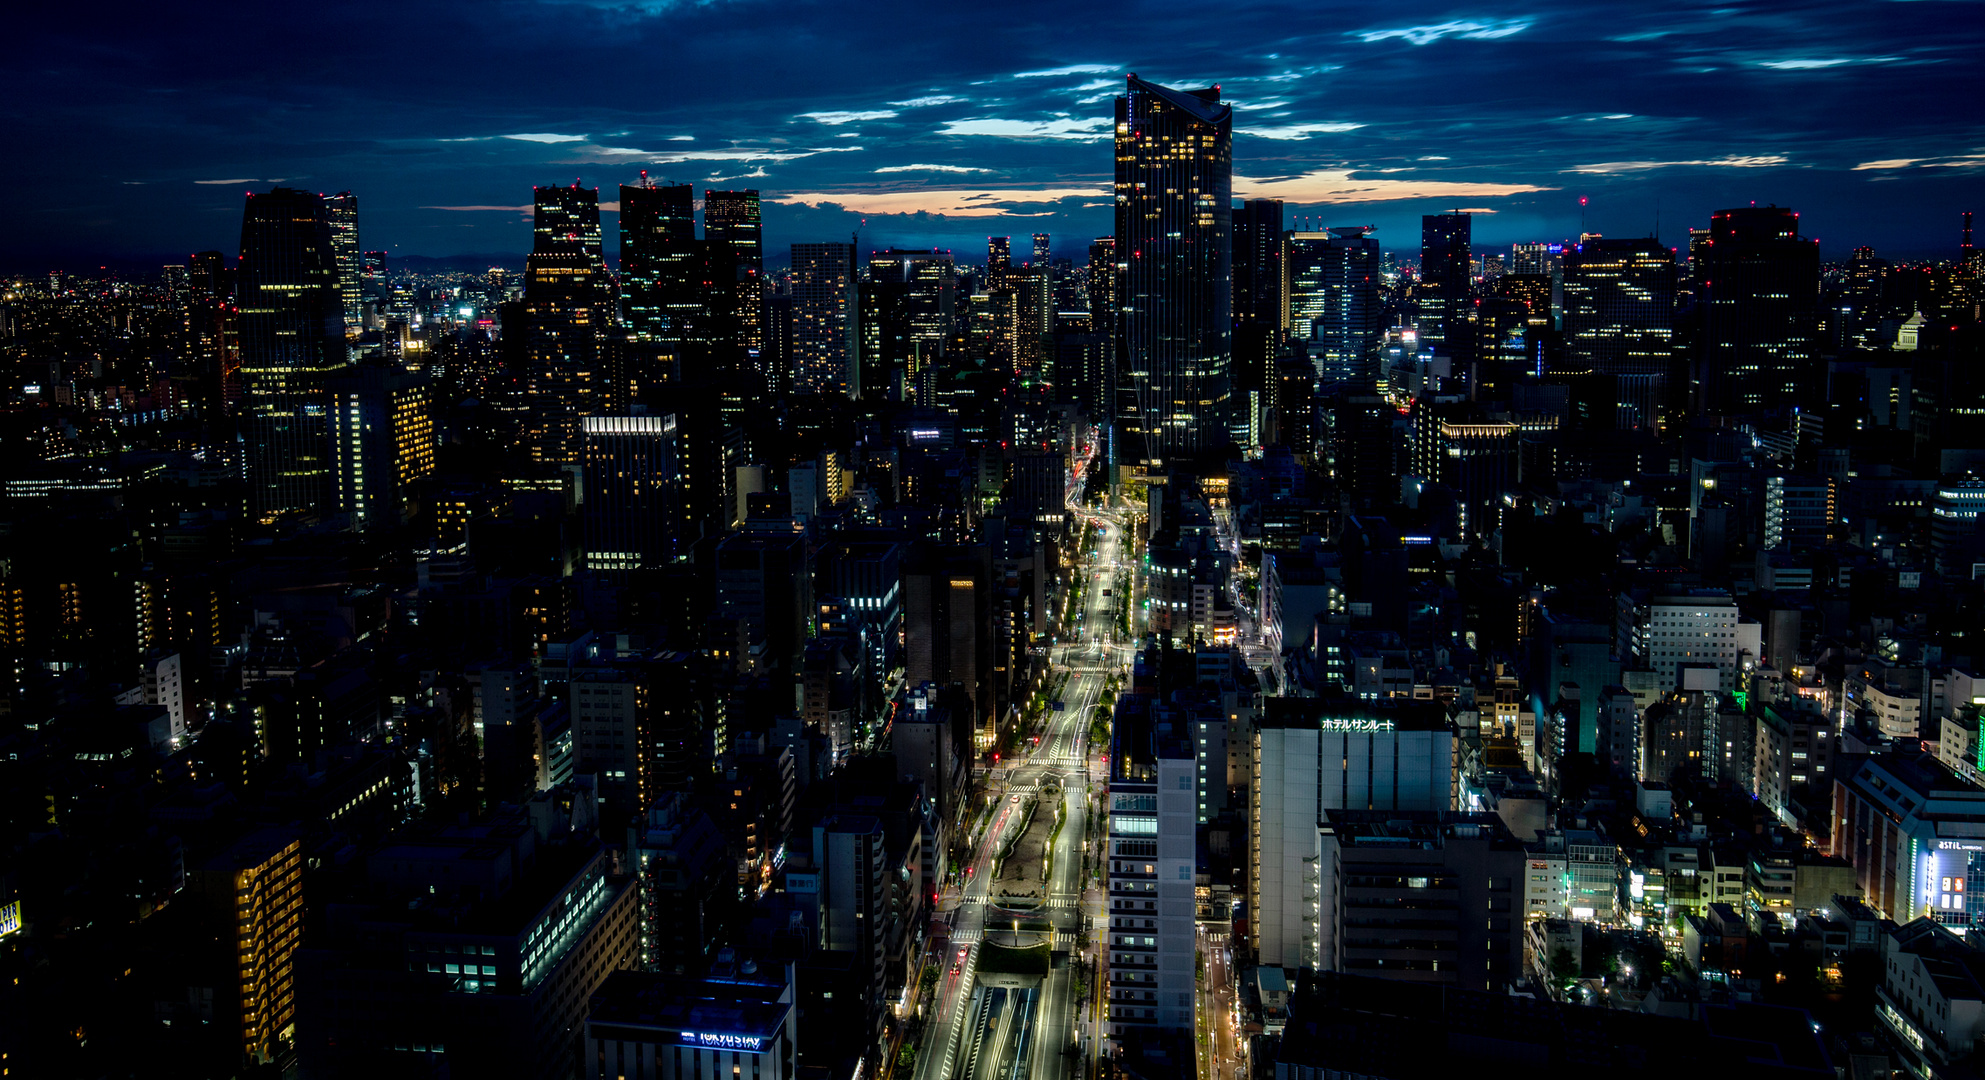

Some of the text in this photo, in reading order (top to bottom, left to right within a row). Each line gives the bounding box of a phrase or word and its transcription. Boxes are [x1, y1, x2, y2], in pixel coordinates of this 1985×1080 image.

[1322, 718, 1395, 731] ホテルサンルート
